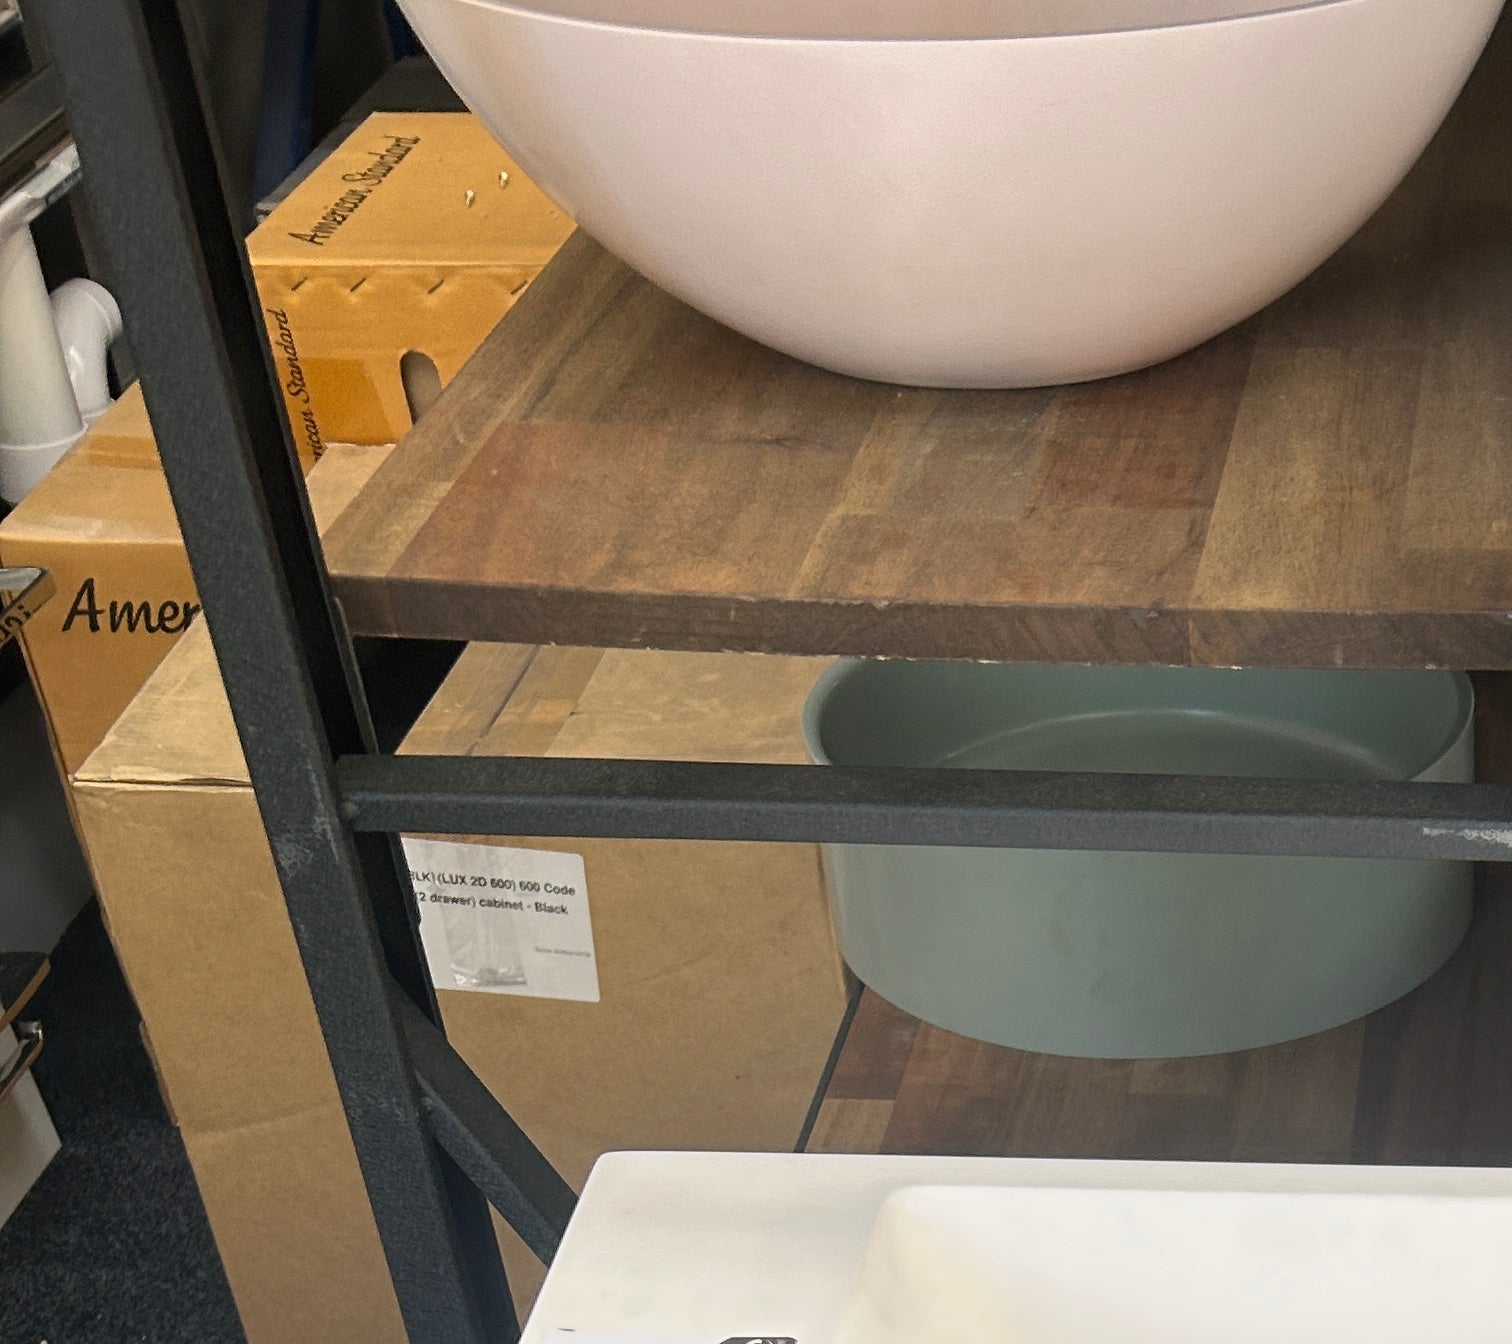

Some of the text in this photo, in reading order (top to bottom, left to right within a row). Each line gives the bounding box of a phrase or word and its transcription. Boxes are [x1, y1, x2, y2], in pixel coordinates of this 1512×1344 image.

[288, 136, 420, 245] American Standard
[267, 309, 309, 404] Standard
[430, 894, 476, 908] drawer)
[479, 898, 524, 911] cabinet
[535, 902, 568, 914] Black
[544, 883, 576, 896] Code
